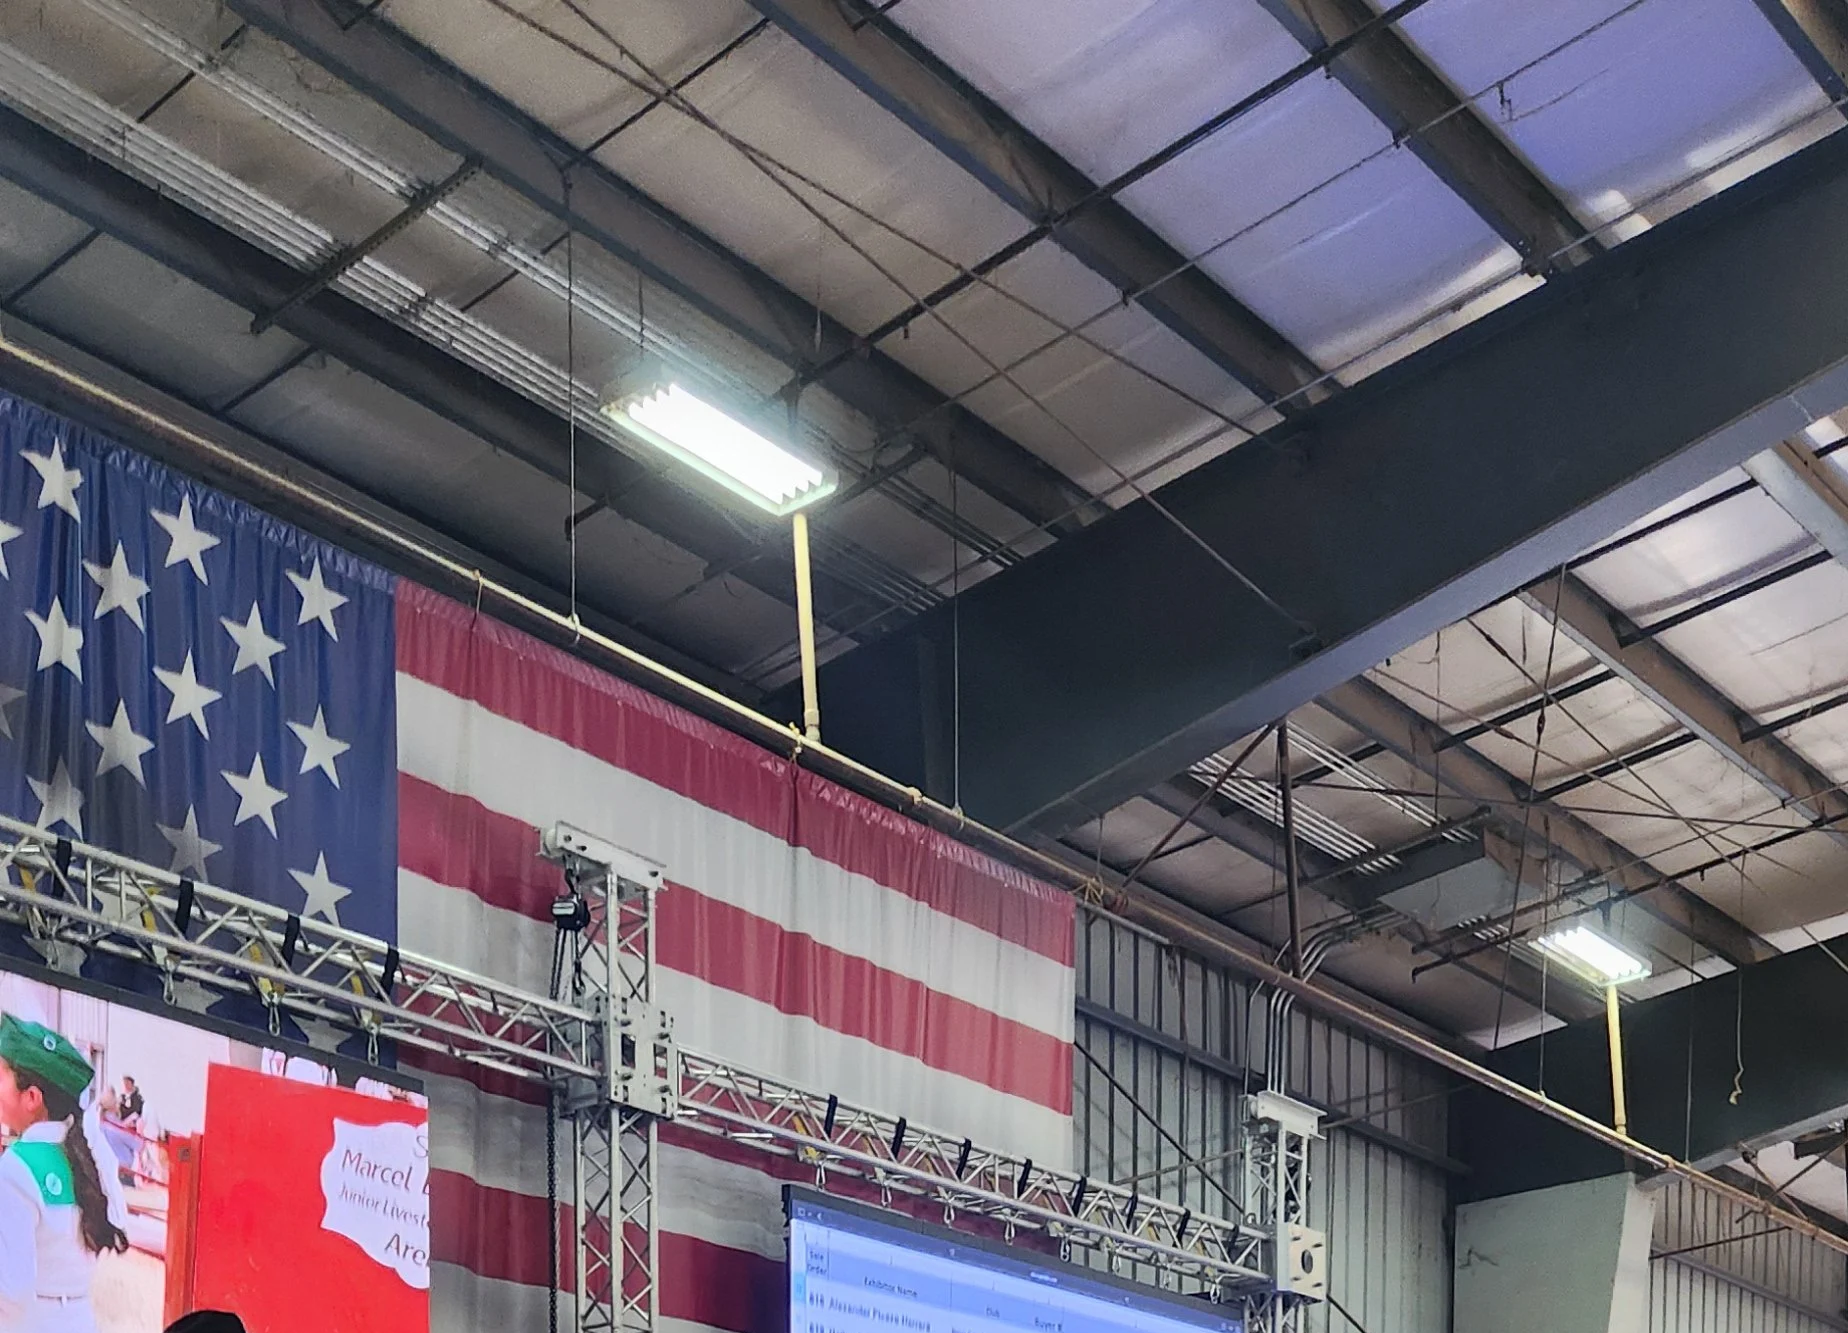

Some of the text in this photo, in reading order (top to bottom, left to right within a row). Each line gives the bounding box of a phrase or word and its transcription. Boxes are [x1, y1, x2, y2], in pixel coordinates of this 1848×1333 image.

[341, 1149, 413, 1191] Marcel
[338, 1182, 380, 1211] Junior
[385, 1232, 429, 1267] Are
